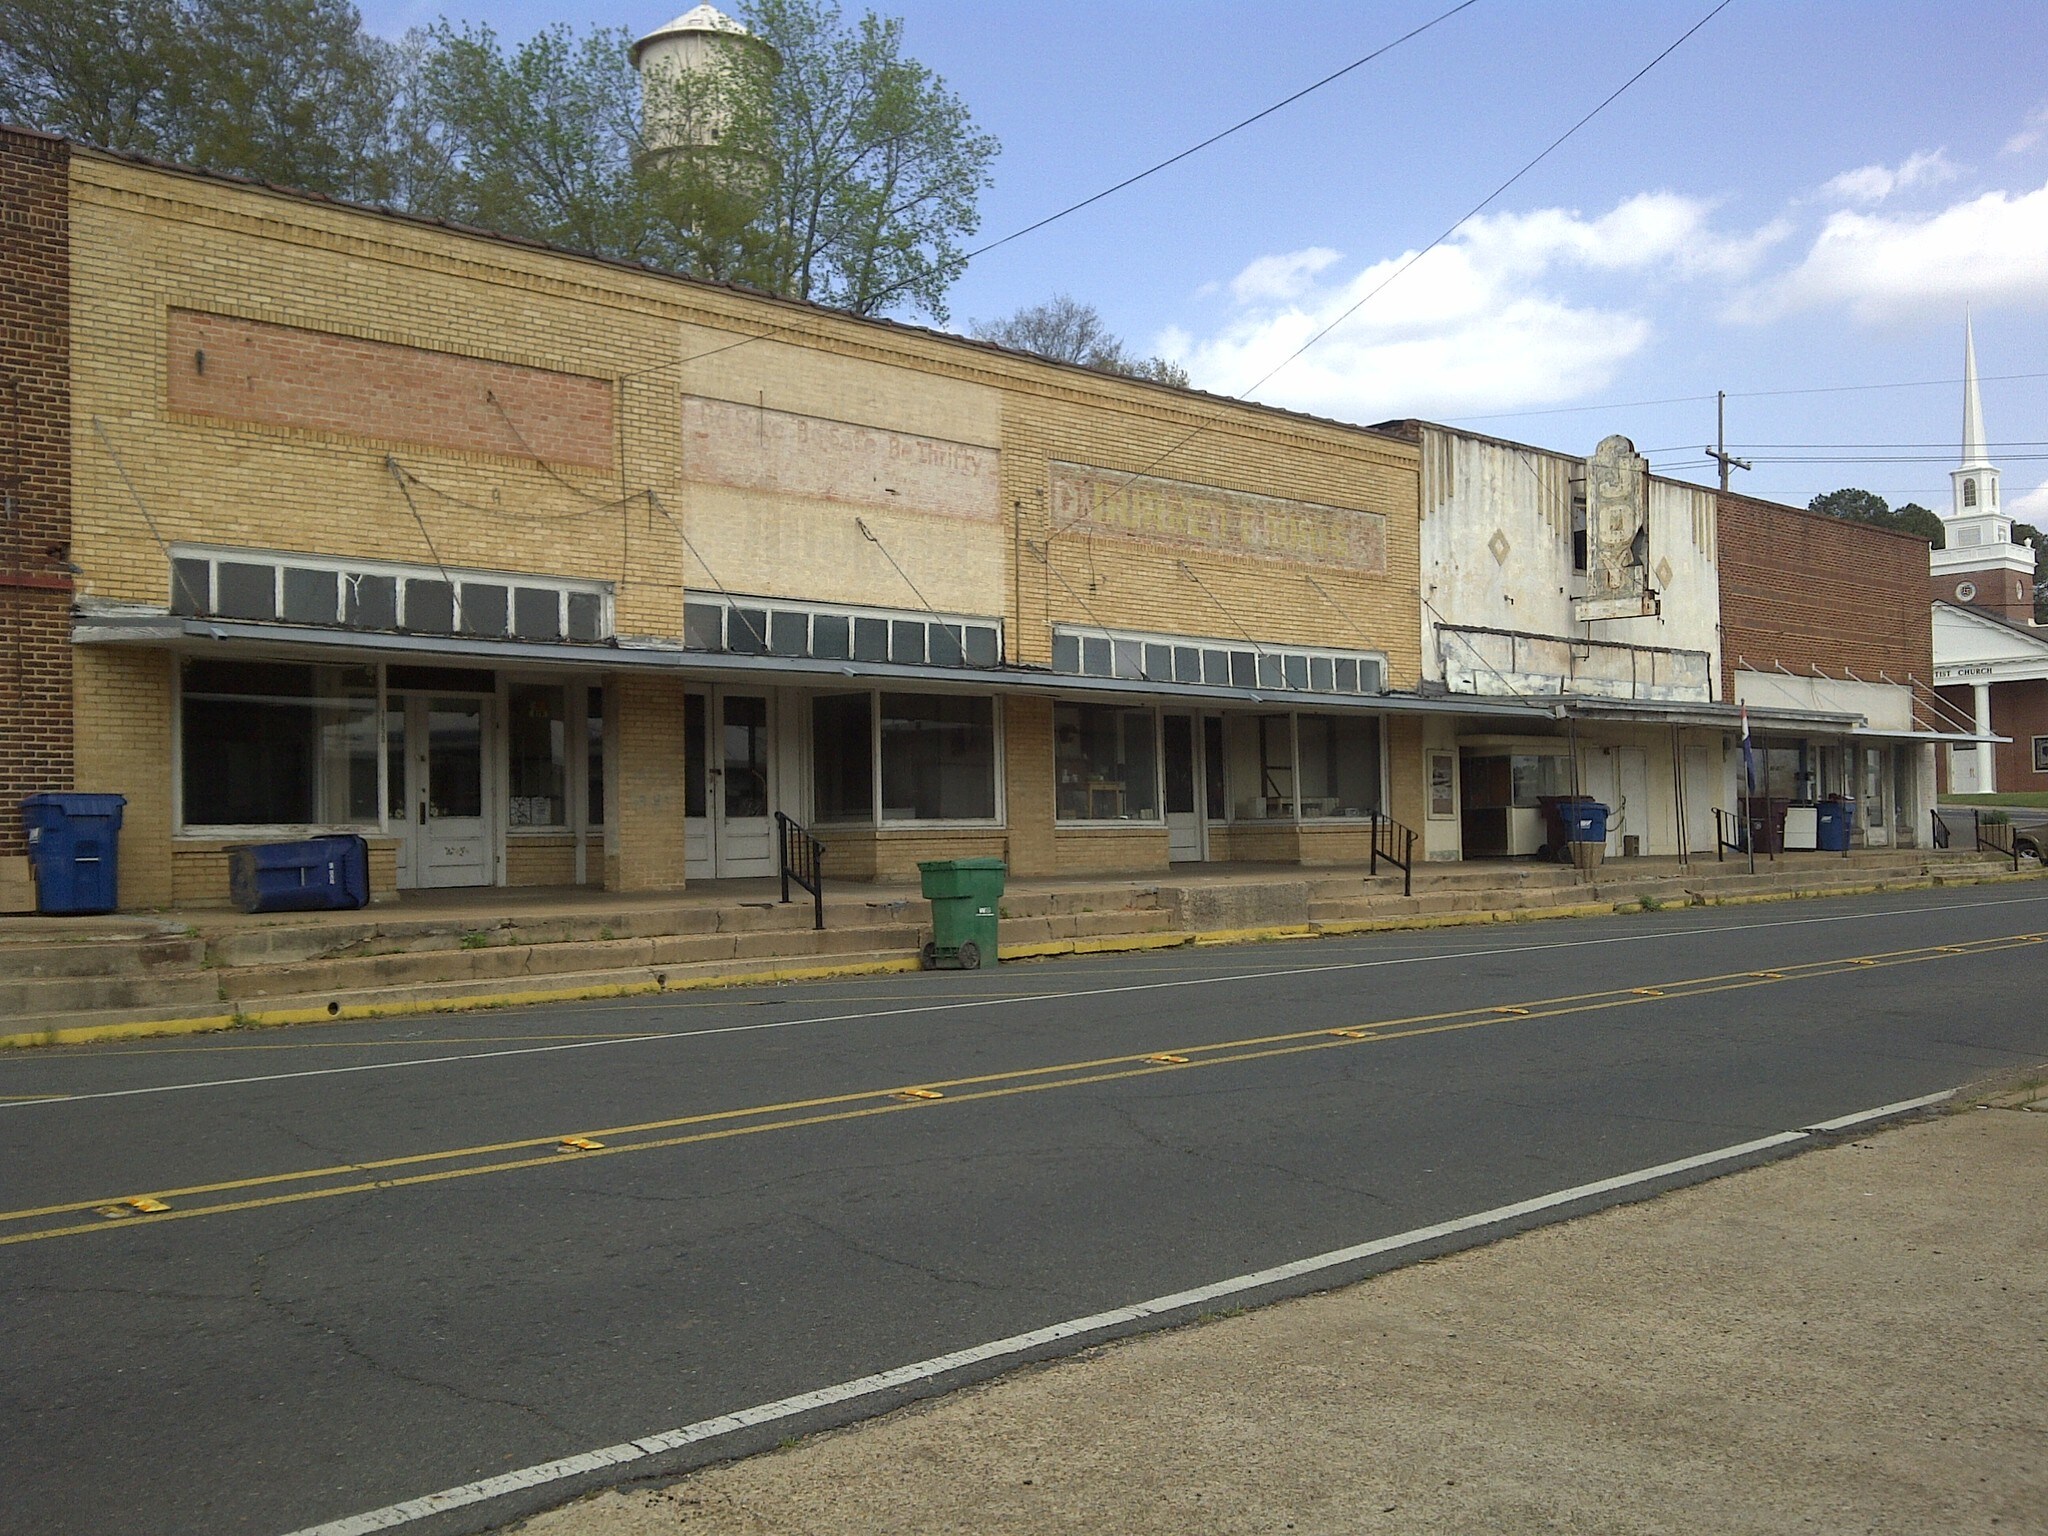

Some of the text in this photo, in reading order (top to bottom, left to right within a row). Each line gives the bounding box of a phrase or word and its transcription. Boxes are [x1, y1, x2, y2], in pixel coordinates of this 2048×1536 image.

[889, 436, 913, 460] Be
[917, 440, 982, 477] Thrifty
[1599, 457, 1635, 589] JOY
[1958, 667, 1993, 676] CHURCH
